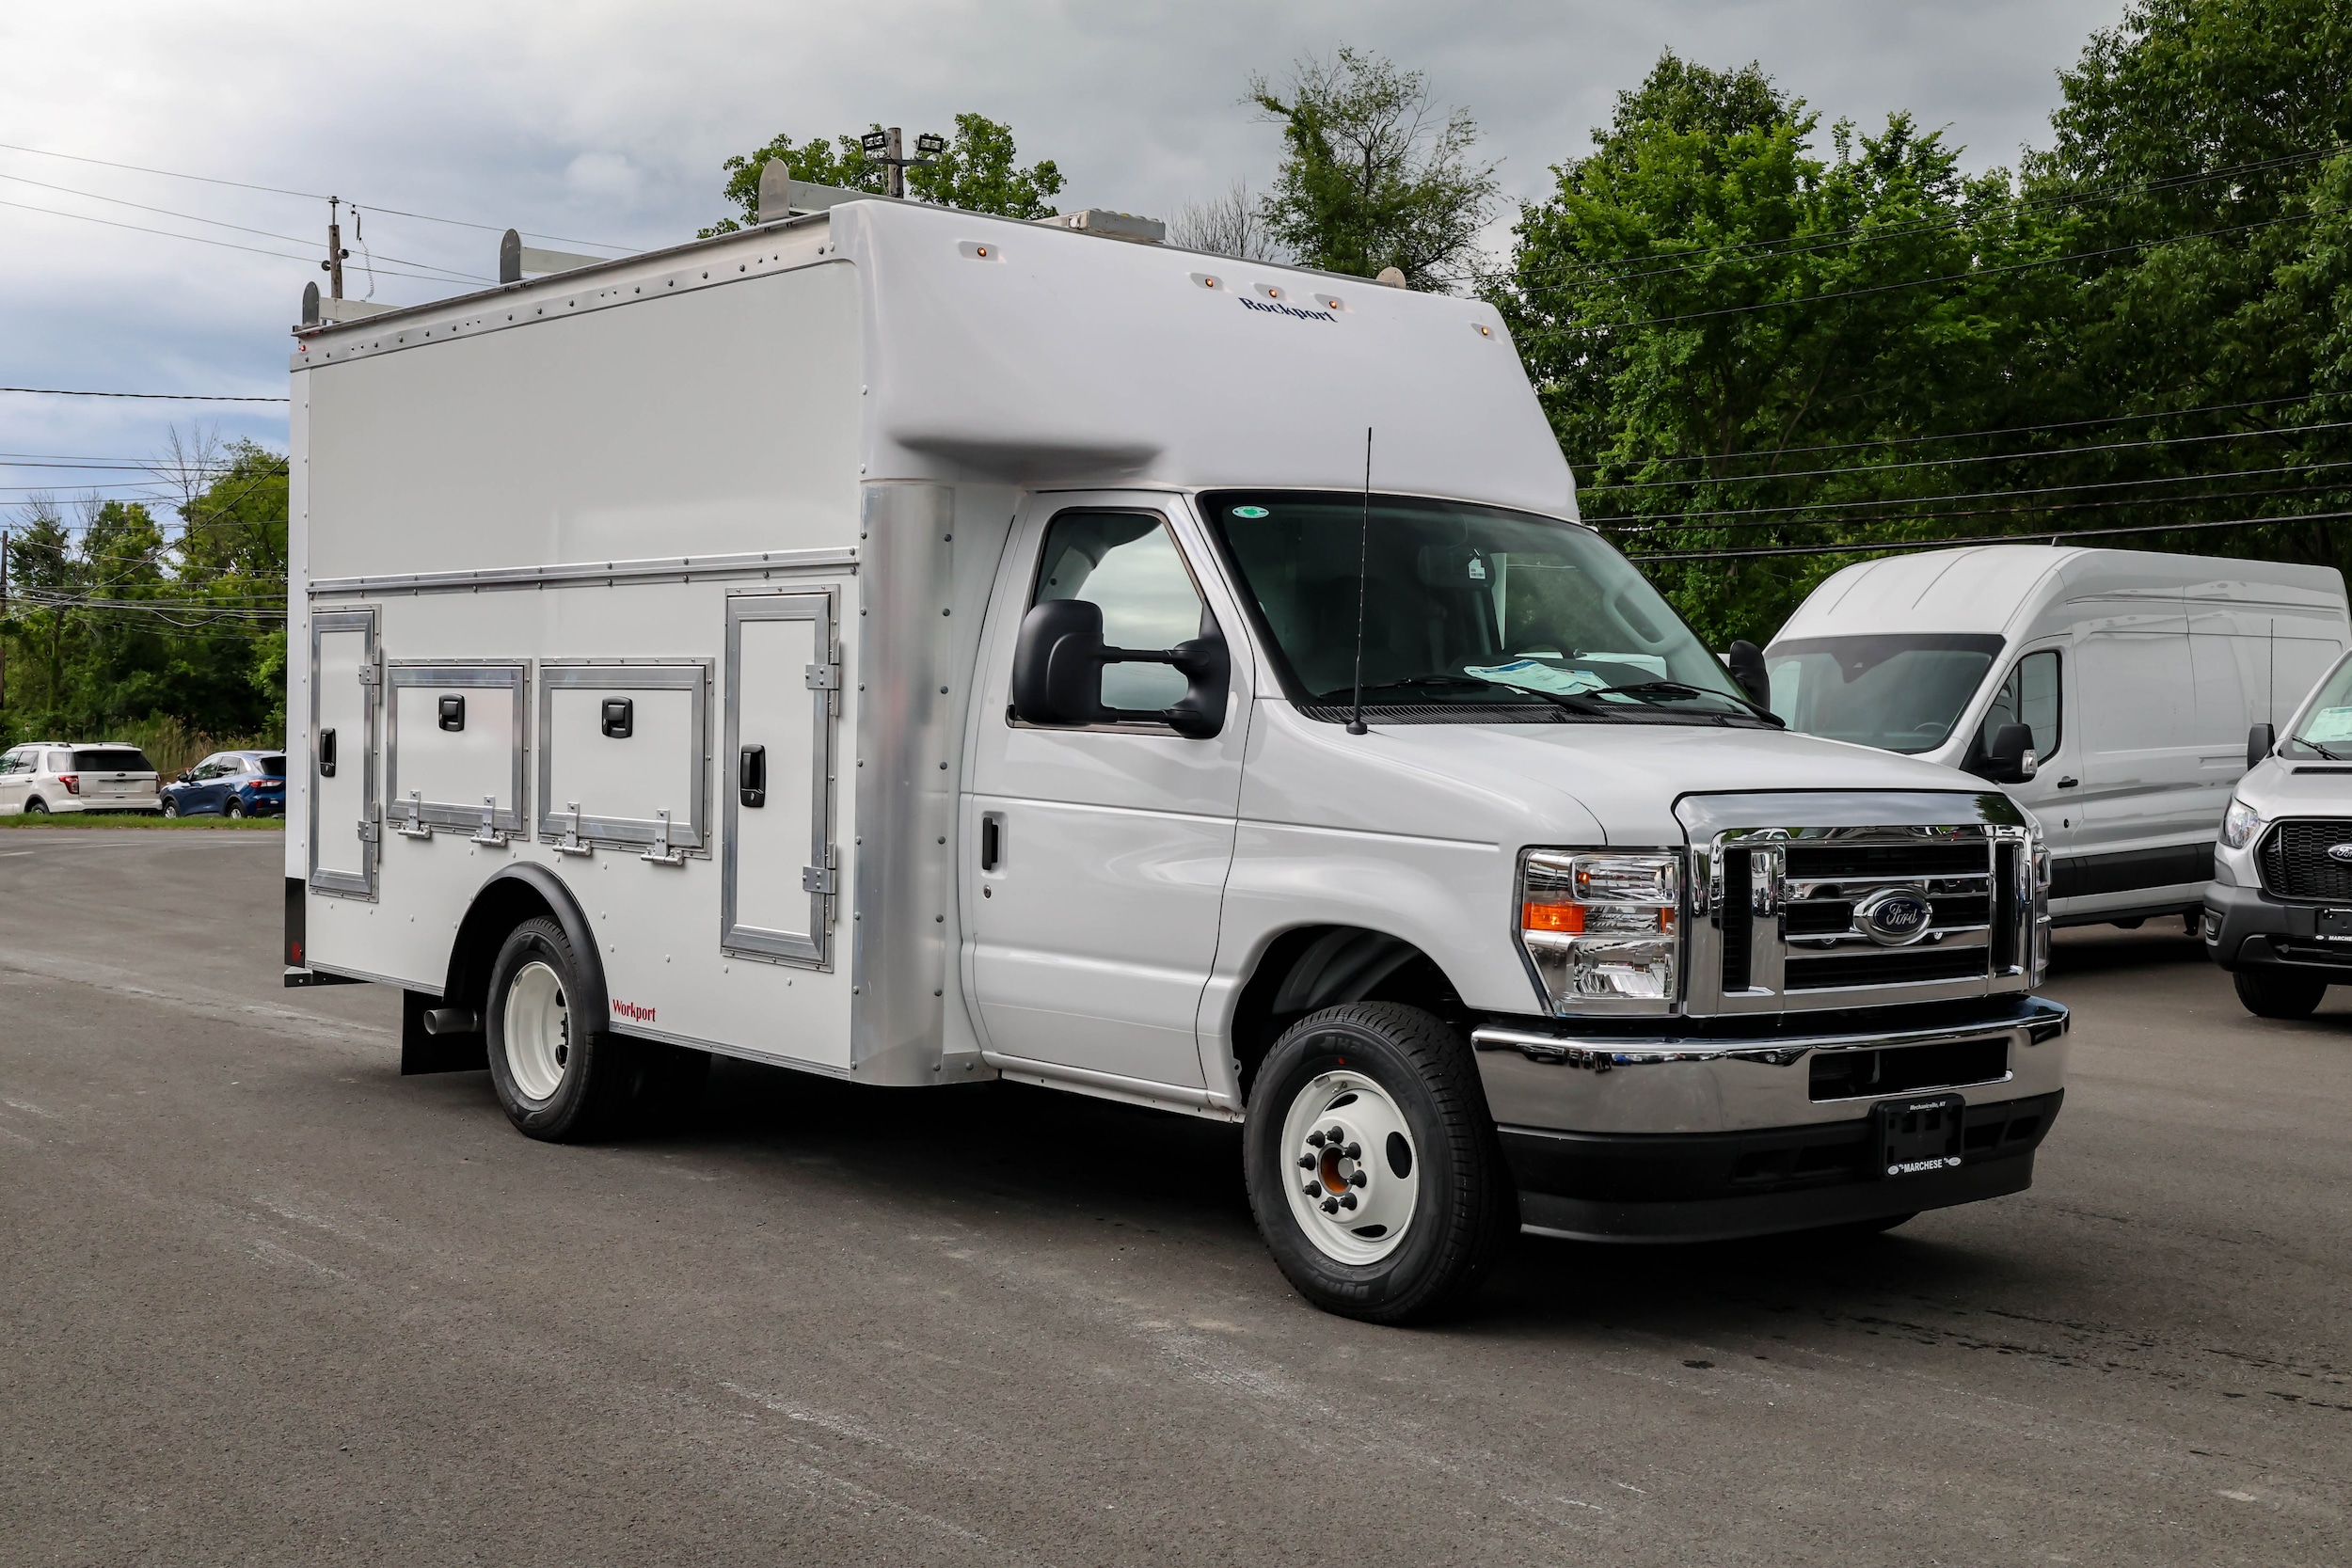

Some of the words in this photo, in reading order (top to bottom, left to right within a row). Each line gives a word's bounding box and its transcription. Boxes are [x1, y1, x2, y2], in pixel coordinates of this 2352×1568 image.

[1238, 296, 1339, 323] Rockport
[1886, 903, 1918, 926] Ford
[612, 998, 657, 1022] Workport
[1903, 1158, 1943, 1173] MARCHESE
